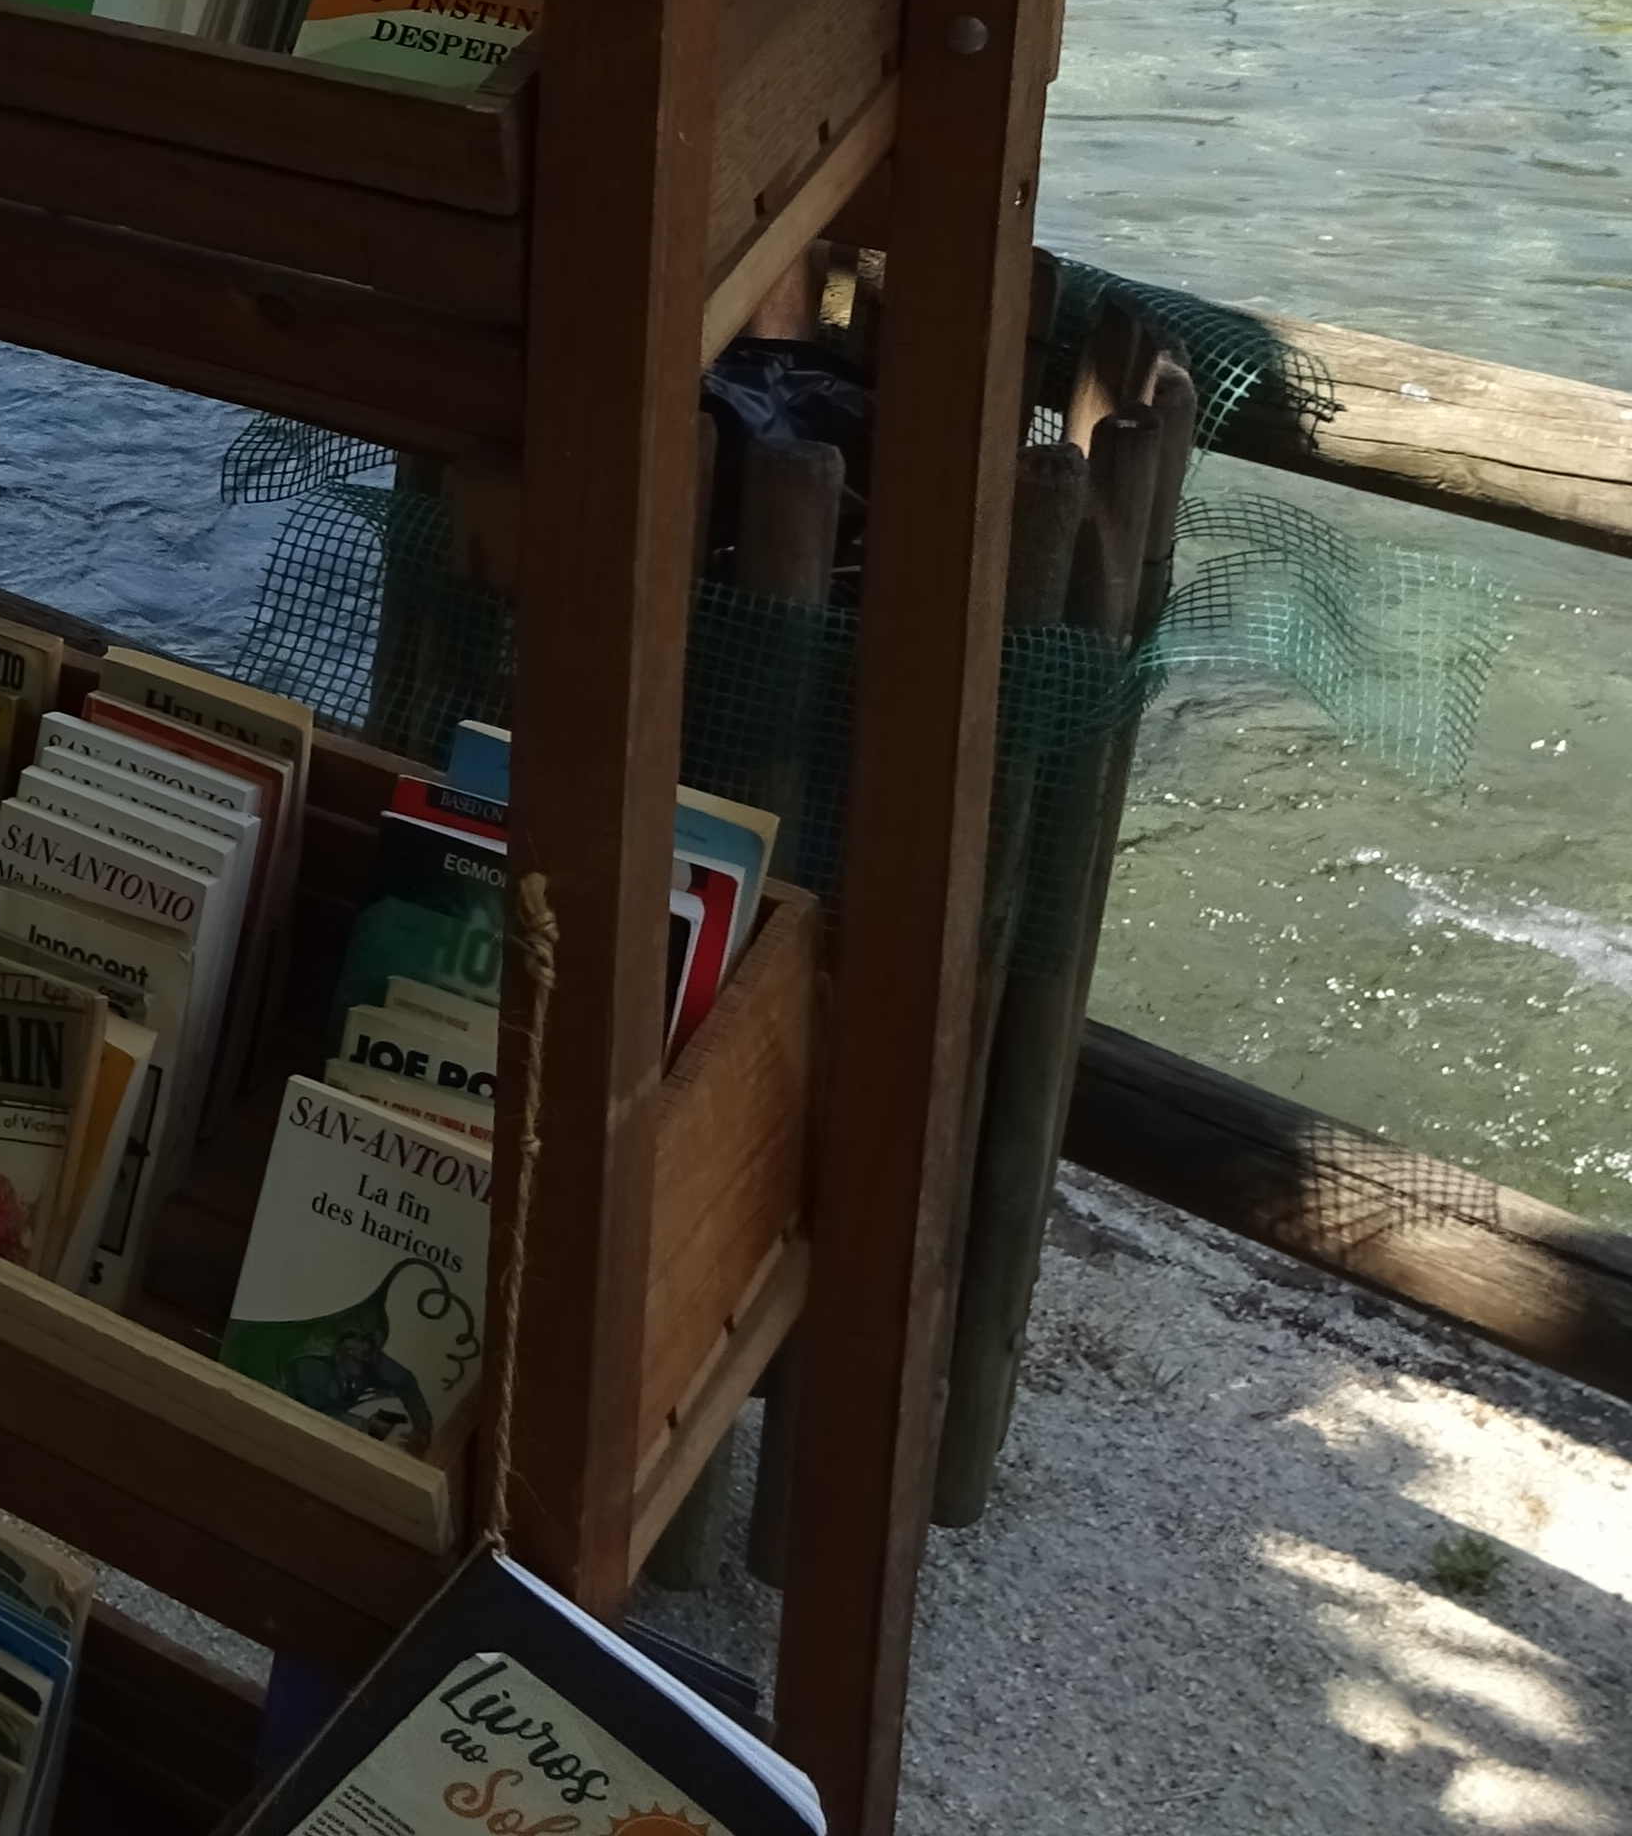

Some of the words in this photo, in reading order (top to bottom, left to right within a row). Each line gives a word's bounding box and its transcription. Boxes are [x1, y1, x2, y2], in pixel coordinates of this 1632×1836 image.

[370, 17, 517, 67] DESPER
[439, 790, 482, 816] BASED
[483, 804, 504, 822] ON
[1, 823, 195, 923] SAN-ANTONIO
[442, 851, 507, 888] EGMO
[349, 1033, 430, 1080] JOE
[3, 1112, 19, 1129] of
[356, 1173, 387, 1206] La
[396, 1190, 431, 1224] fin
[311, 1190, 354, 1226] des
[360, 1209, 463, 1273] haricots
[439, 1660, 610, 1805] Livros
[440, 1728, 488, 1765] ao
[443, 1768, 582, 1836] Sol
